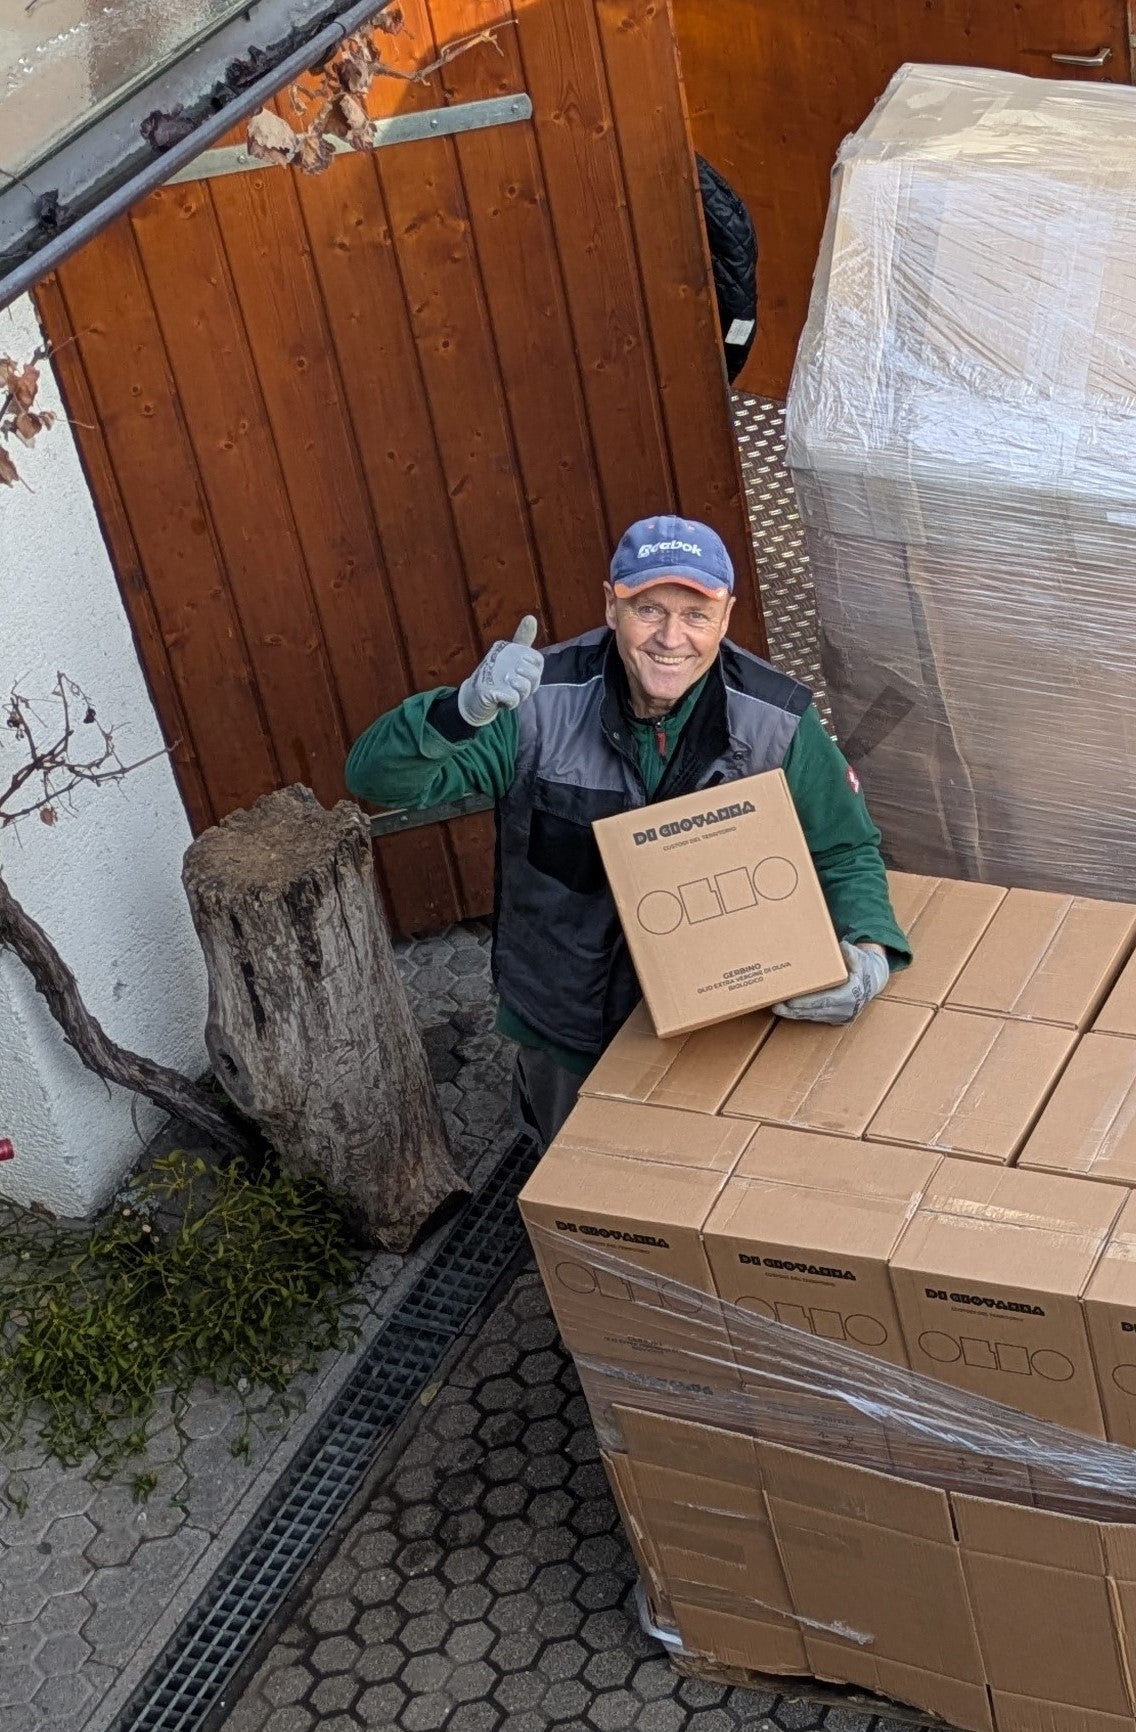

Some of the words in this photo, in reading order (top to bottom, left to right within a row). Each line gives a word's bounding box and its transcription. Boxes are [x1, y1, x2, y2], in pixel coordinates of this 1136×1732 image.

[637, 540, 702, 559] Reebok
[632, 828, 658, 846] DI
[659, 800, 756, 837] GIOVANNA
[722, 963, 762, 979] GERBINO
[738, 1253, 761, 1266] DI
[763, 1258, 857, 1281] GIOVANNA
[924, 1288, 948, 1301] DI
[949, 1293, 1046, 1317] GIOVANNA
